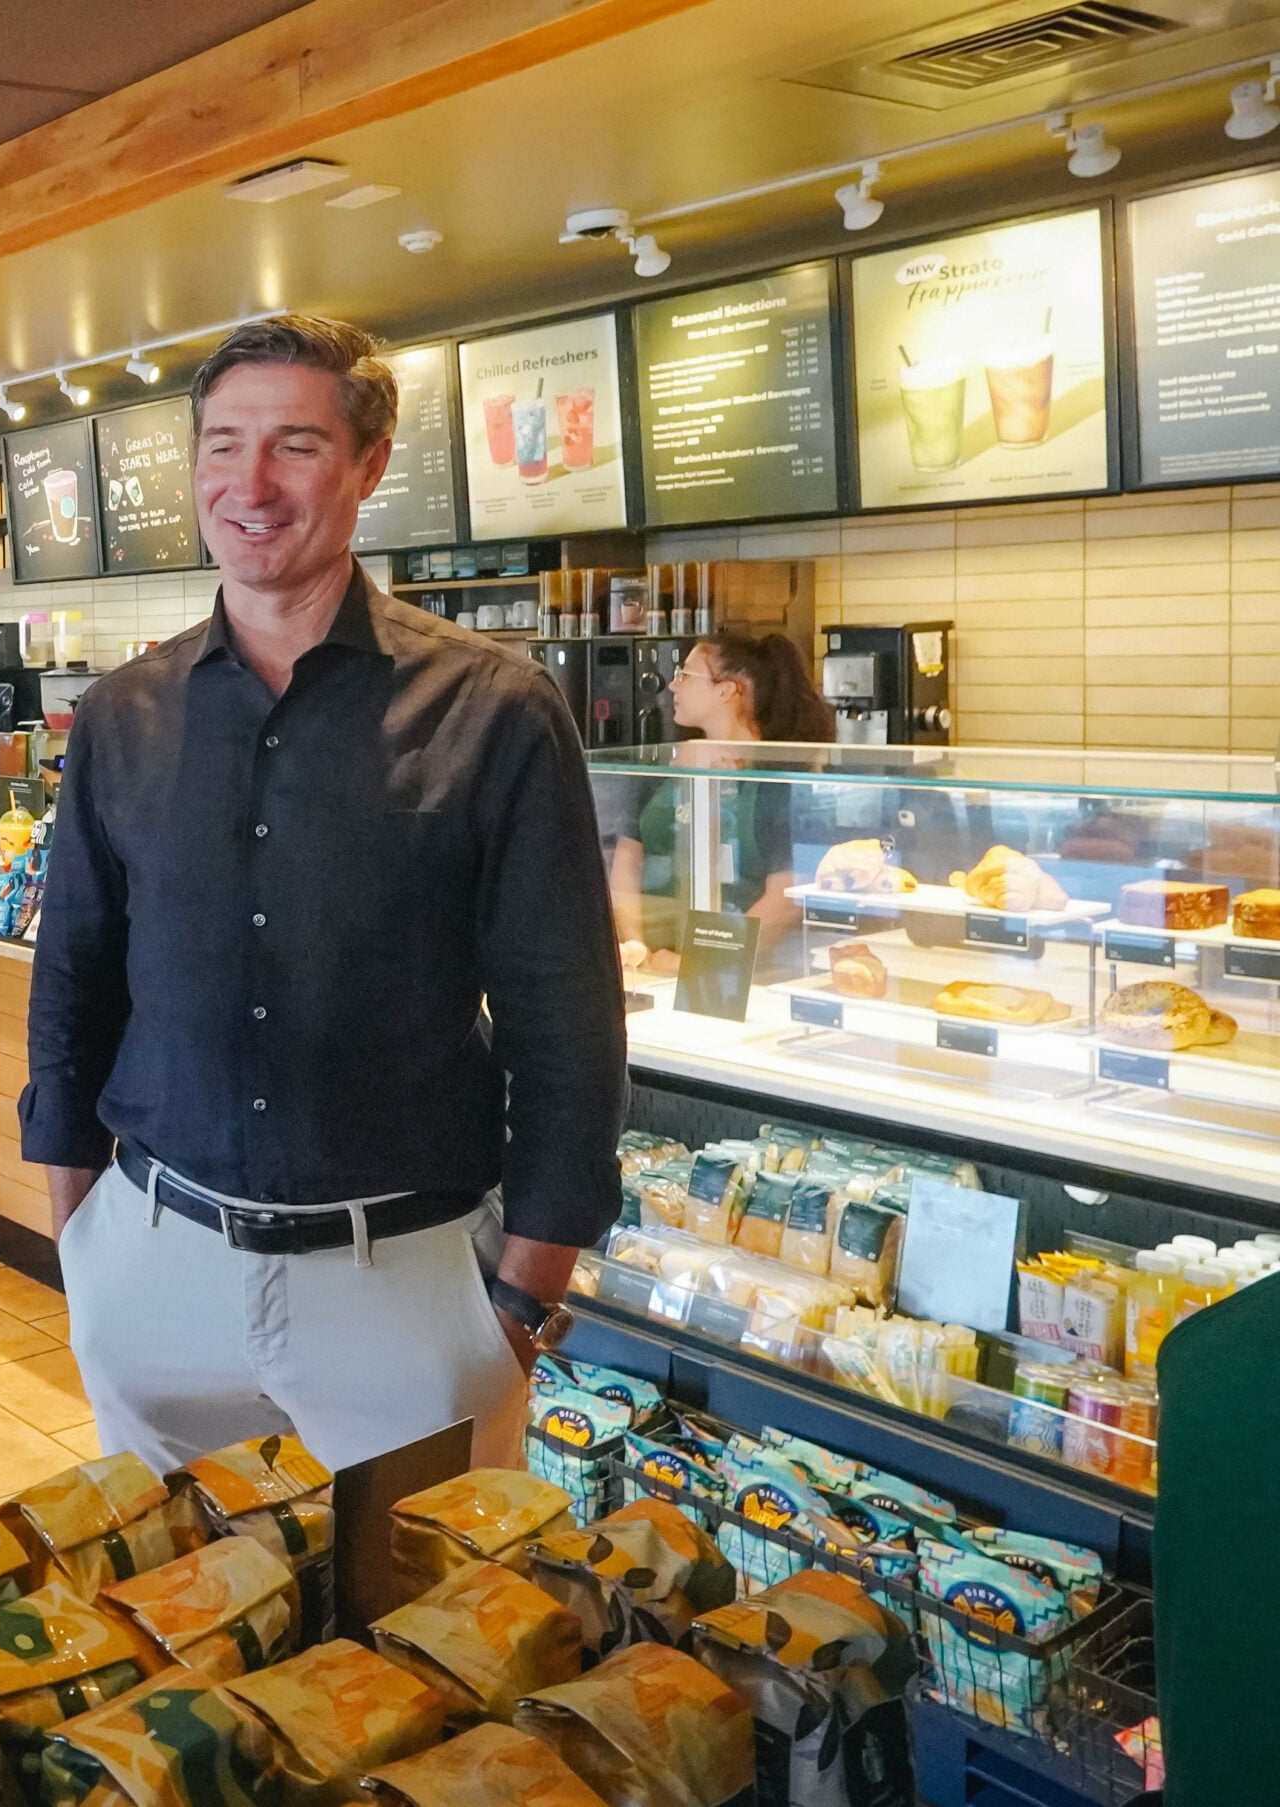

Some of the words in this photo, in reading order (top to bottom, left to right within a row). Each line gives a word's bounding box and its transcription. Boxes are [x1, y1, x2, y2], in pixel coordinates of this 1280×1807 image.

[905, 262, 936, 277] NEW
[938, 258, 1004, 280] Strato
[671, 306, 723, 328] Seasonal
[724, 297, 788, 318] Selections
[1226, 345, 1254, 360] Iced
[1255, 344, 1279, 356] Tea
[476, 362, 520, 380] Chilled
[522, 349, 599, 372] Refreshers
[1212, 371, 1236, 380] Latte
[732, 392, 766, 405] Blended
[768, 387, 811, 400] Beverages
[1200, 385, 1223, 394] Latte
[1220, 391, 1268, 404] Lemonade
[1223, 403, 1271, 416] Lemonade
[112, 441, 118, 456] A
[155, 431, 174, 446] DAY
[757, 444, 799, 455] Beverages
[13, 448, 51, 468] Raspberry
[120, 454, 151, 472] STARTS
[156, 447, 180, 464] HERE
[18, 478, 34, 492] Cold
[24, 485, 40, 498] Brew
[714, 930, 733, 939] Delight
[558, 1410, 588, 1428] SIETE
[758, 1488, 790, 1510] SIETE
[872, 1498, 900, 1512] SIET
[1004, 1556, 1044, 1574] SIETE
[964, 1587, 1006, 1608] SIETE
